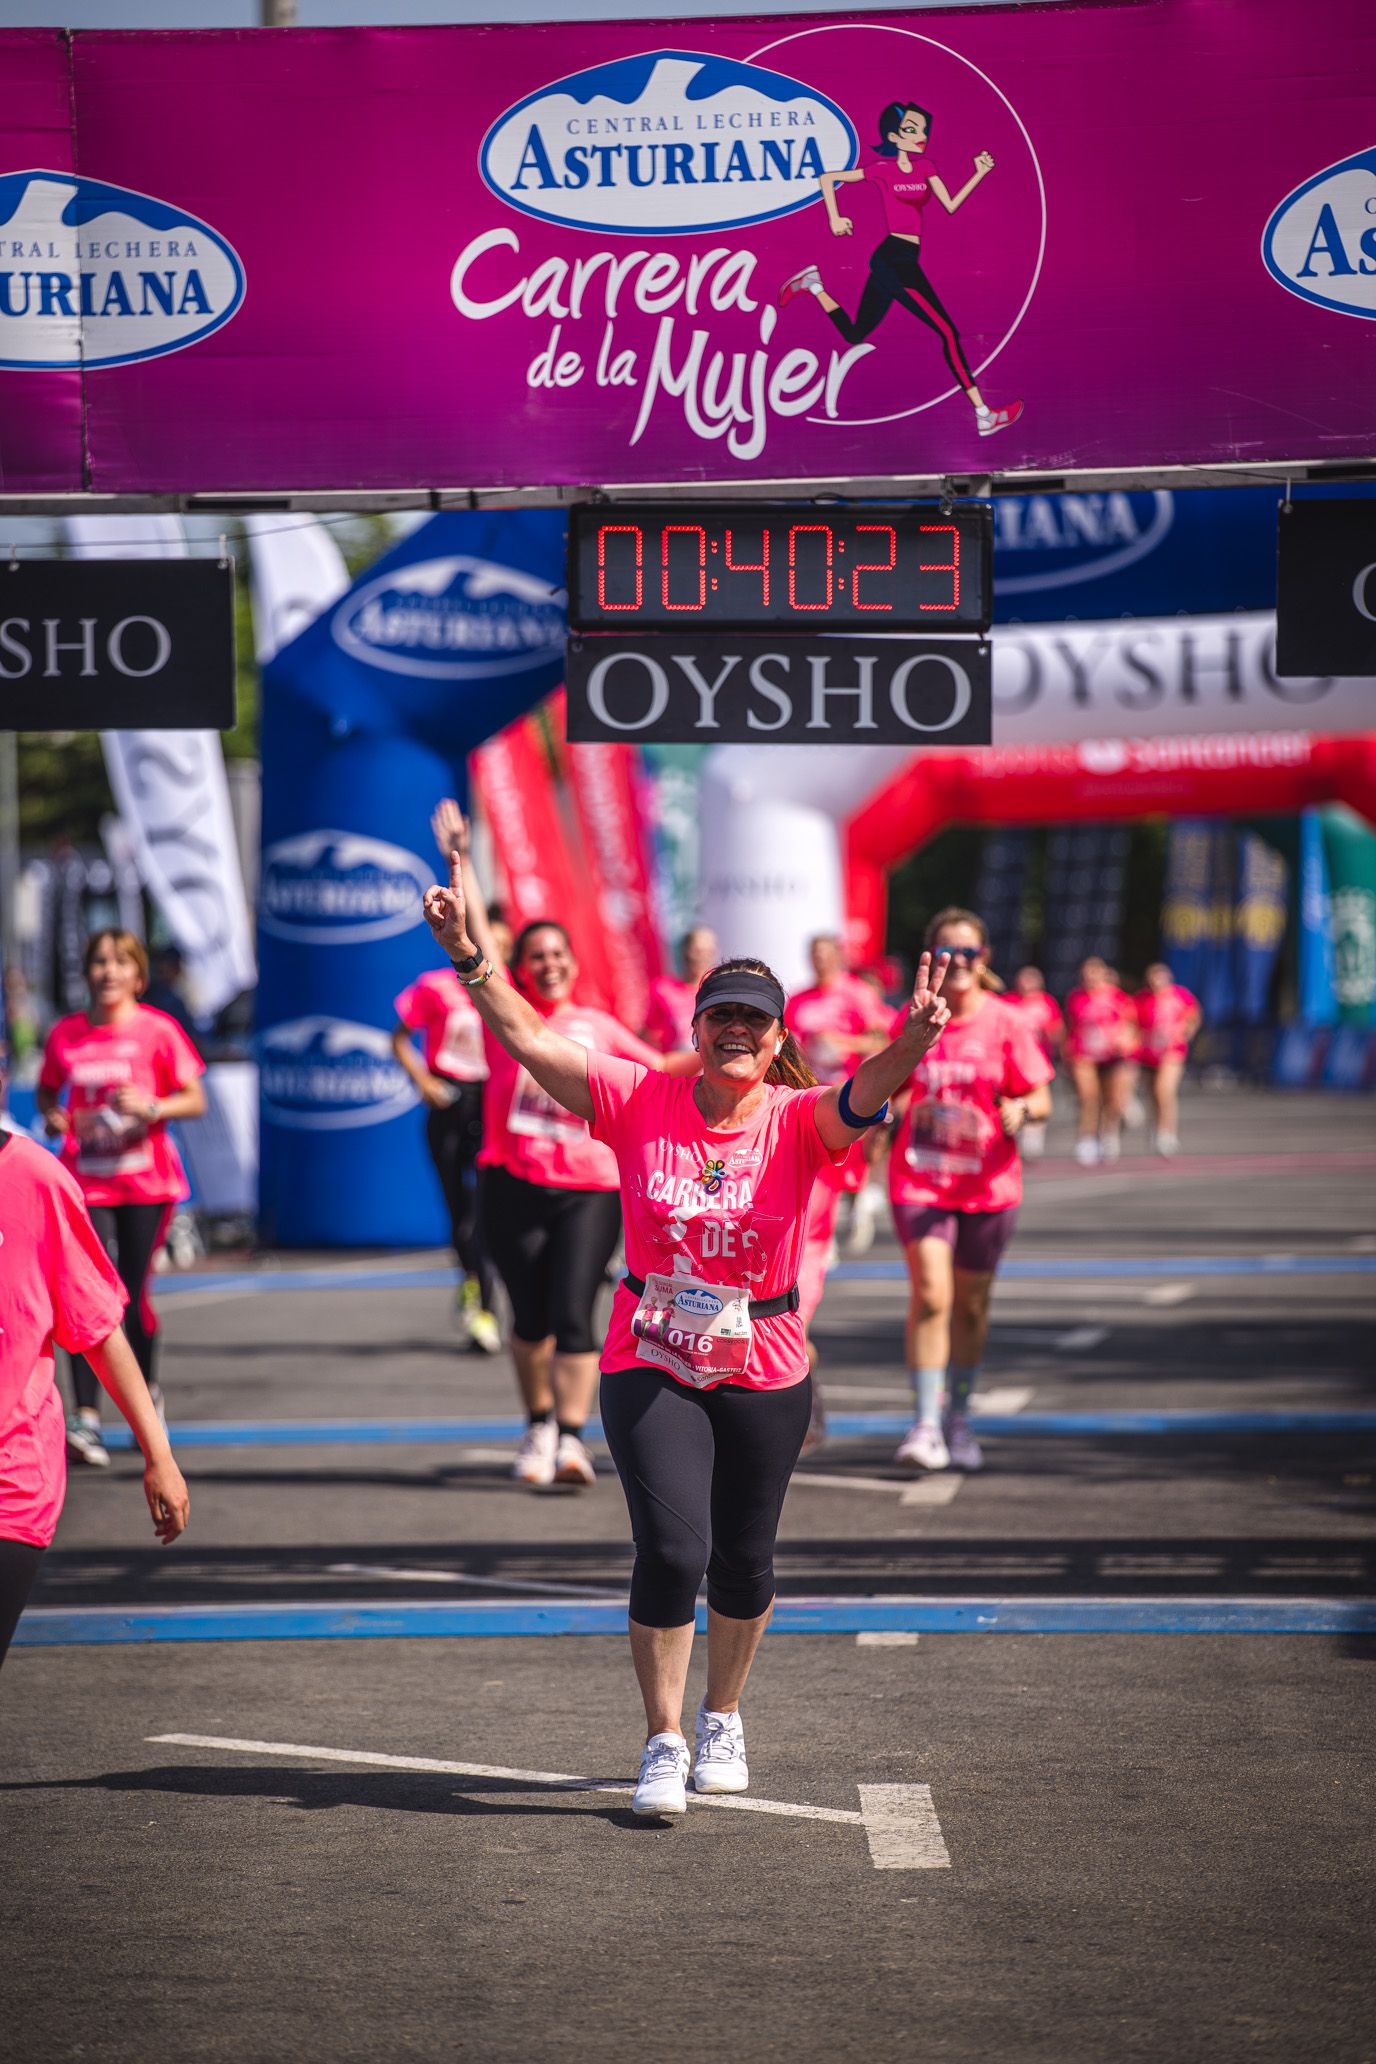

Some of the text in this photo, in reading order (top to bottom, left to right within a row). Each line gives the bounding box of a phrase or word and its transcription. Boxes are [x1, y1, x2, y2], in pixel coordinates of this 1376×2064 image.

[566, 110, 817, 135] CENTRAL LECHERA
[510, 123, 827, 191] ASTURIANA
[75, 240, 199, 259] LECHERA
[450, 227, 759, 320] Carrera
[526, 303, 878, 461] de la Mujer
[597, 525, 961, 611] 00:40:23
[0, 614, 172, 680] SHO
[586, 651, 973, 732] OYSHO
[660, 1139, 701, 1163] OYSHO
[678, 1294, 720, 1312] ASTURIANA
[651, 1348, 681, 1371] OYSHO
[667, 1329, 714, 1353] 016
